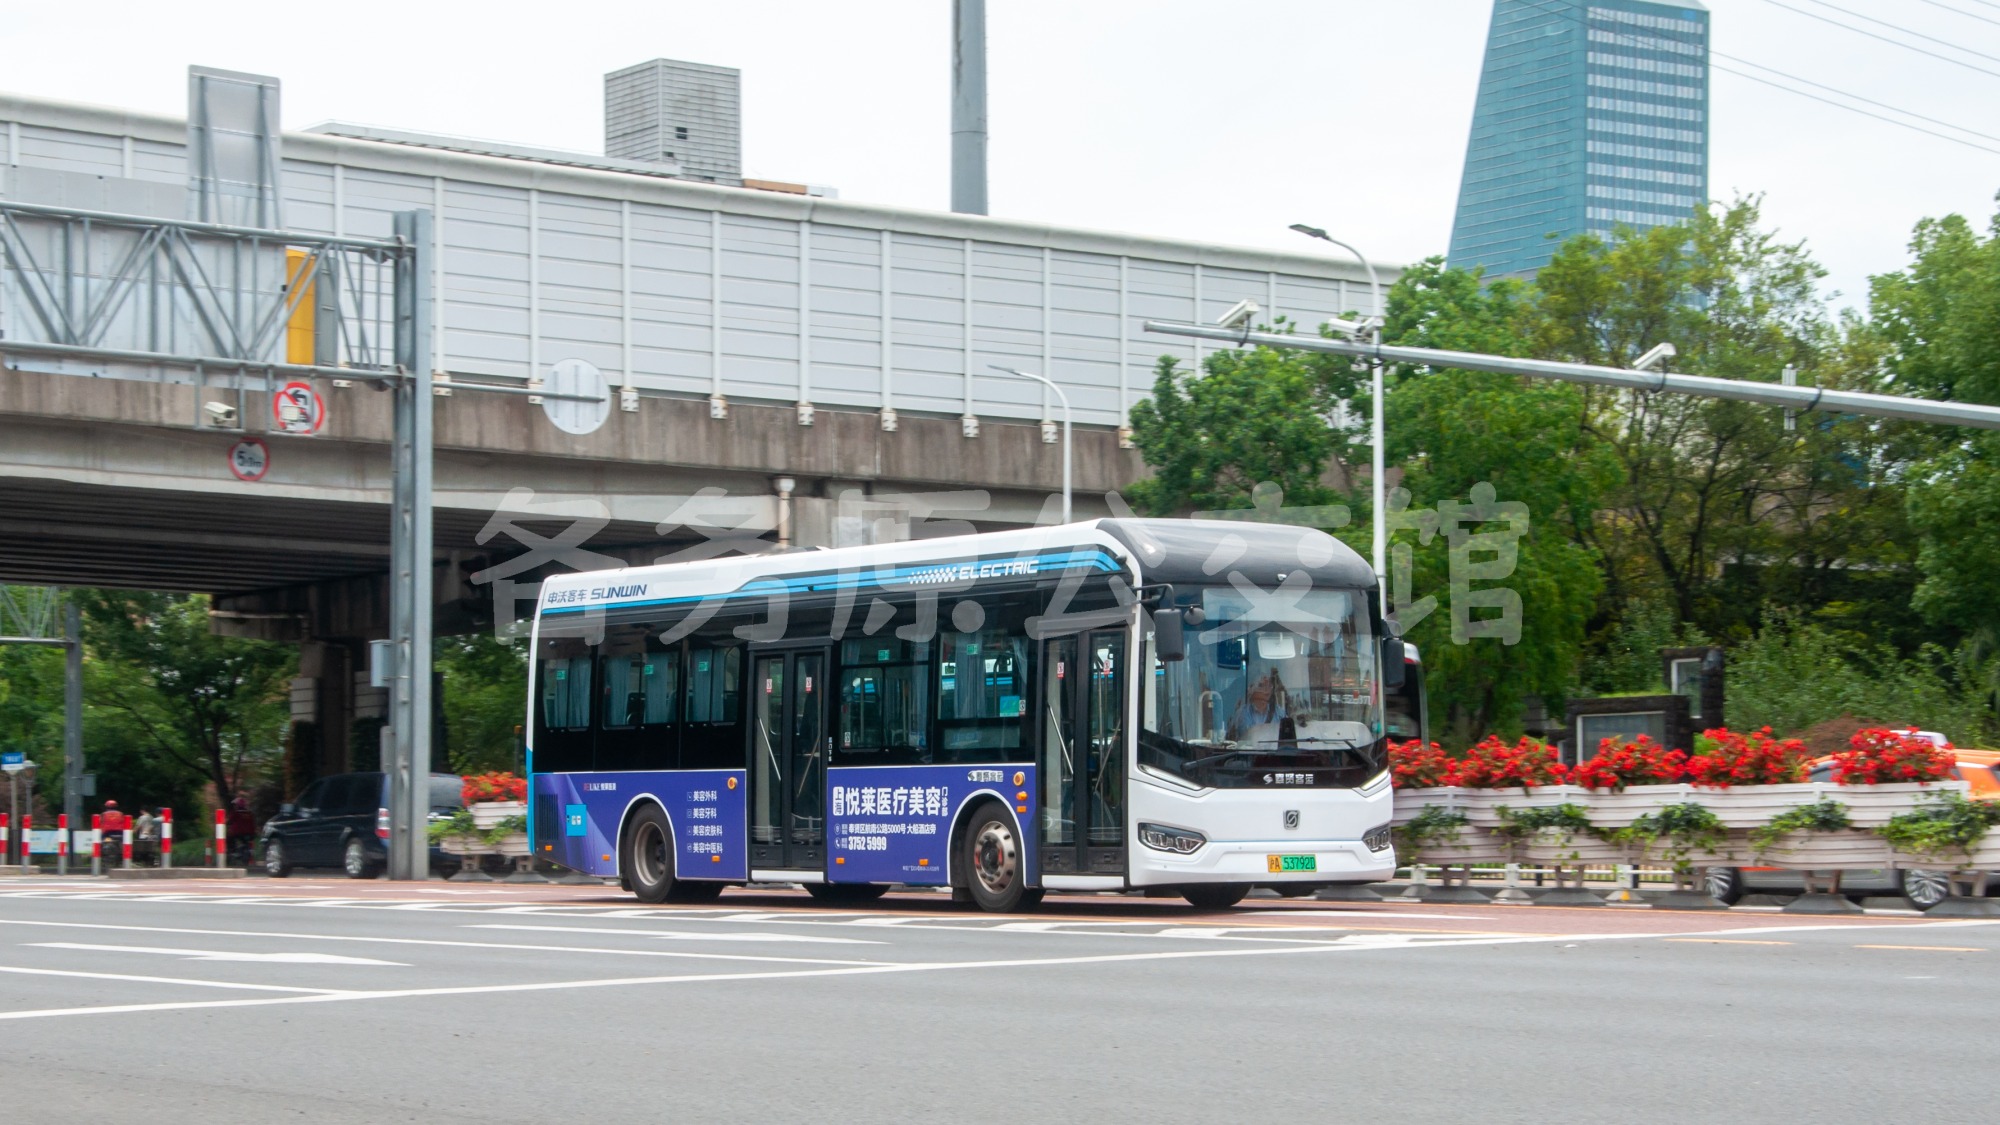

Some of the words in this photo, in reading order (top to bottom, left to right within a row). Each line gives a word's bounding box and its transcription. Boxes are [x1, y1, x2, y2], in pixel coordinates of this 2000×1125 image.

[959, 560, 1039, 580] ELECTRIC
[548, 589, 587, 604] 申沃客车
[590, 584, 648, 600] SUNWIN
[693, 790, 717, 801] 美容外科
[845, 786, 941, 816] 悦莱医疗美容
[693, 808, 717, 818] 美容牙科
[693, 825, 723, 836] 美容皮肤科
[693, 842, 723, 853] 美容中医科
[848, 836, 866, 850] 3752
[867, 836, 887, 850] 5999
